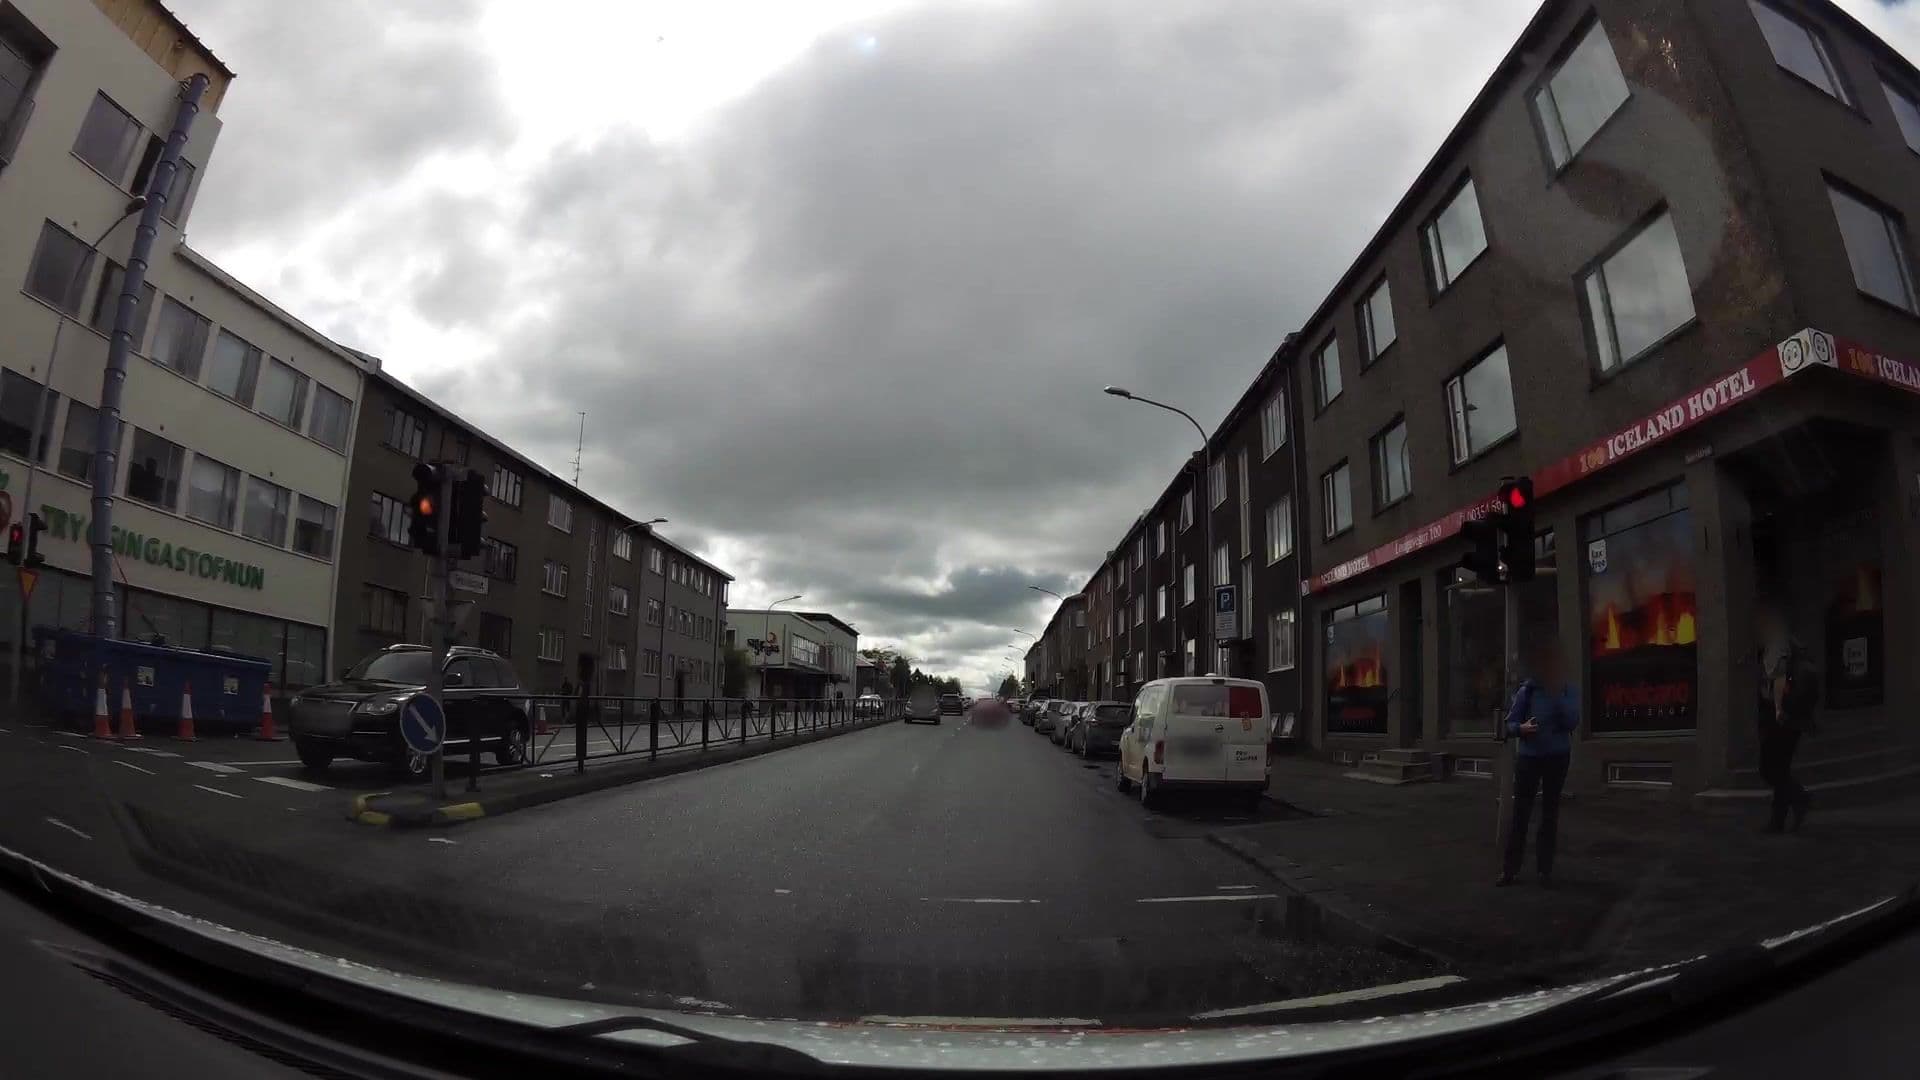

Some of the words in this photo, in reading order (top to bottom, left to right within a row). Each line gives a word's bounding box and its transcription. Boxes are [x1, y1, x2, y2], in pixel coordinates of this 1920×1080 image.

[1607, 404, 1685, 460] ICELAND
[1687, 367, 1756, 420] HOTEL
[1221, 592, 1230, 609] P
